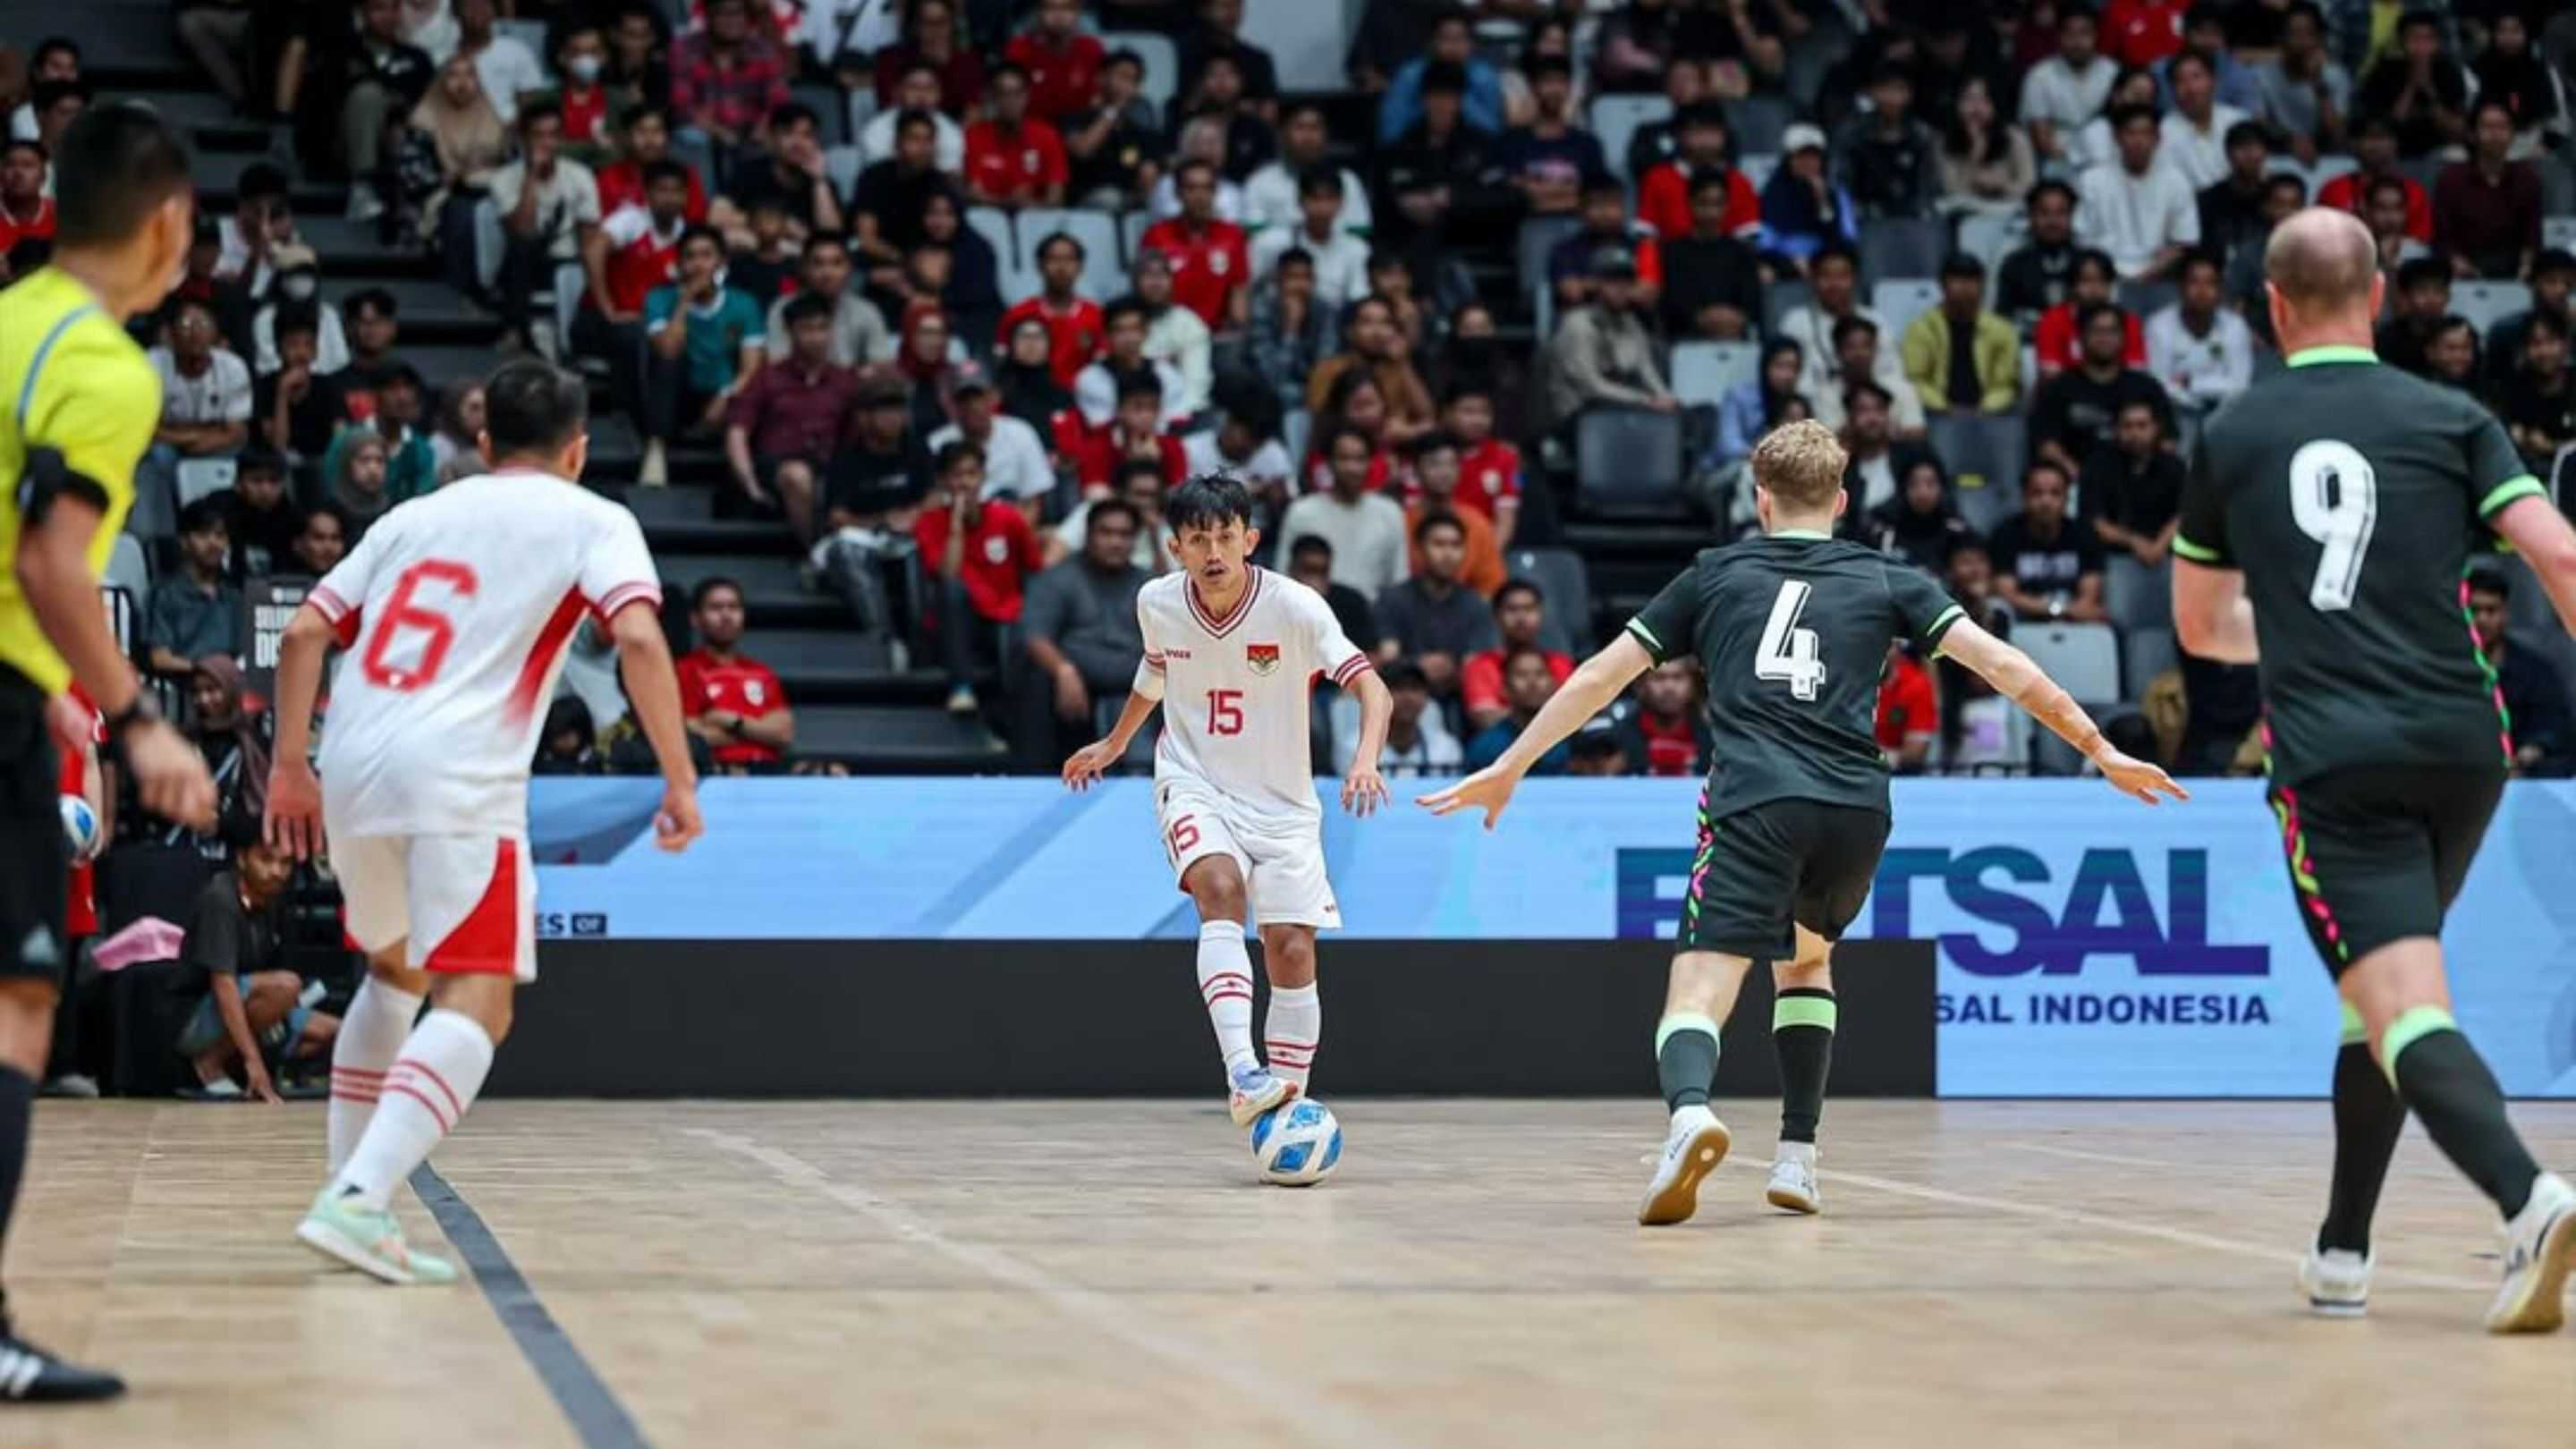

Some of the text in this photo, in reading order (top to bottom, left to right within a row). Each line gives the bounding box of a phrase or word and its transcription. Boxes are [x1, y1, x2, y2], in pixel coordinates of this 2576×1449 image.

[2290, 438, 2377, 612] 9
[361, 559, 480, 693] 6
[1754, 580, 1826, 701] 4
[1207, 690, 1244, 735] 15
[1166, 814, 1201, 862] 15
[1615, 846, 2270, 977] FTSAL
[2029, 994, 2271, 1025] INDONESIA
